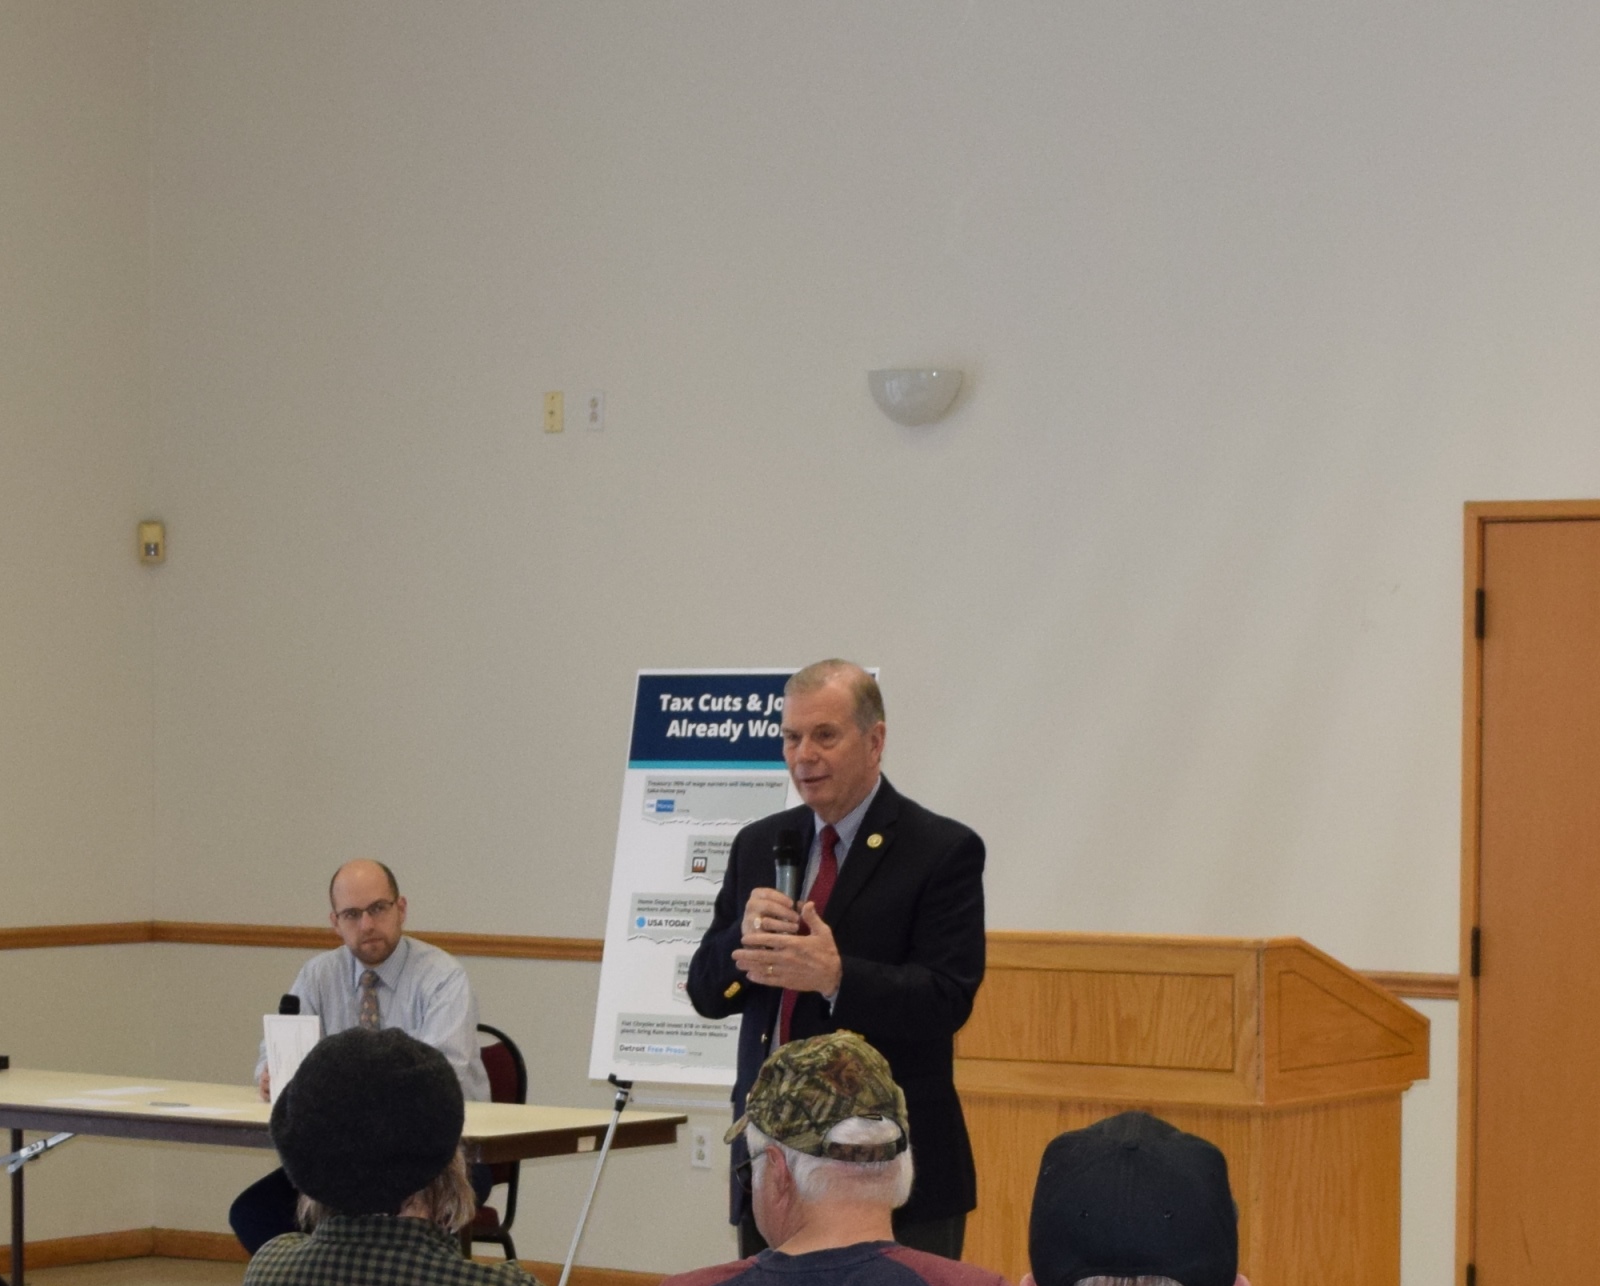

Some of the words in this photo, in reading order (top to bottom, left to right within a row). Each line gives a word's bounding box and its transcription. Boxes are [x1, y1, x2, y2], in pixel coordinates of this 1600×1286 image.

[658, 693, 694, 712] Tax
[698, 693, 742, 712] Cuts
[746, 693, 763, 712] &
[666, 718, 743, 743] Already
[647, 919, 663, 927] USA
[664, 919, 691, 927] TODAY
[619, 1044, 645, 1052] Detroit
